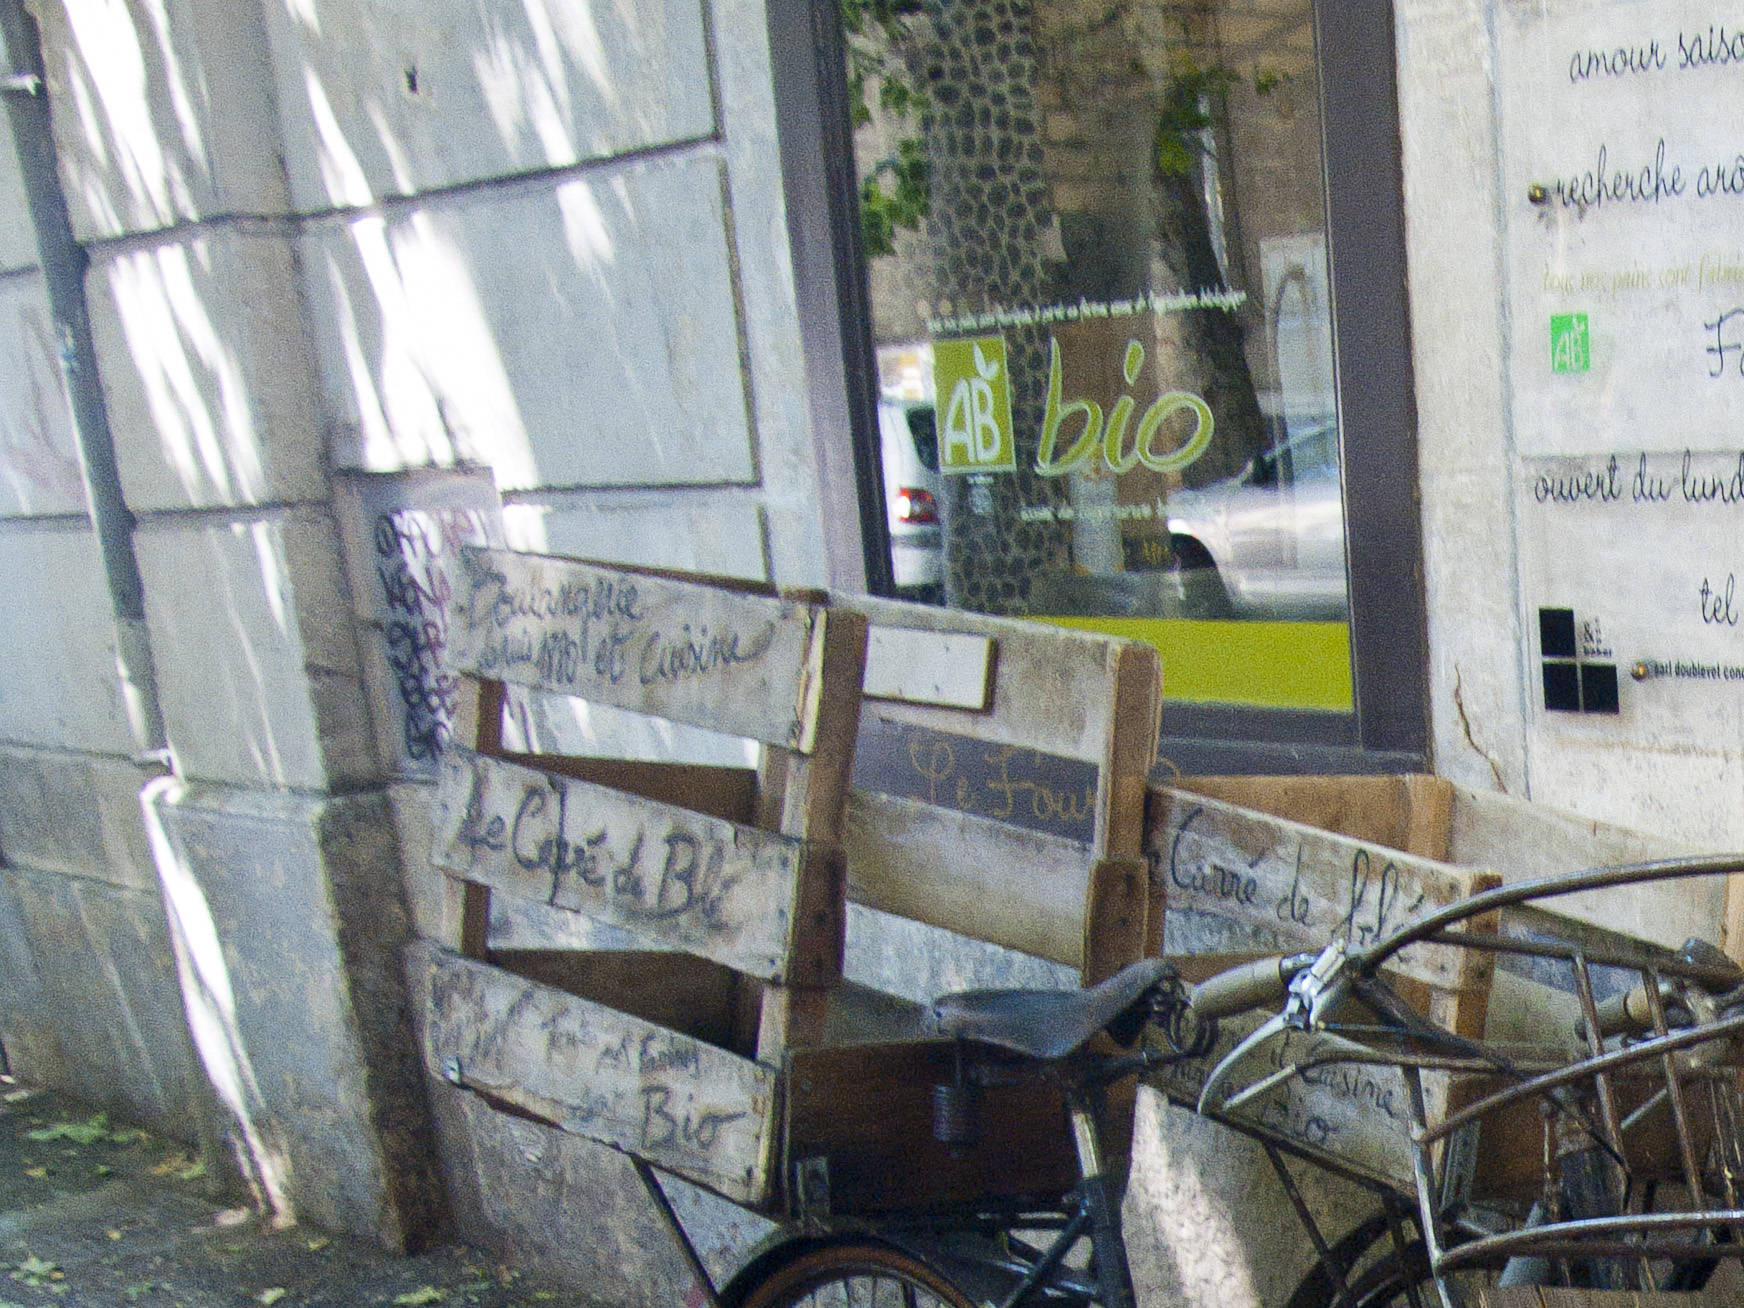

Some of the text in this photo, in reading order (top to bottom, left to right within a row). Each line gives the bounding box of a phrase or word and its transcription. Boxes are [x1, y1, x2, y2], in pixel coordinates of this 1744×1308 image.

[1568, 38, 1667, 84] amour
[1554, 136, 1687, 209] recherche
[1034, 333, 1216, 477] bio
[1534, 452, 1622, 504] ouvert
[1631, 450, 1672, 504] du
[1698, 572, 1739, 627] tel
[1276, 840, 1312, 928] de
[639, 1083, 748, 1150] Bio
